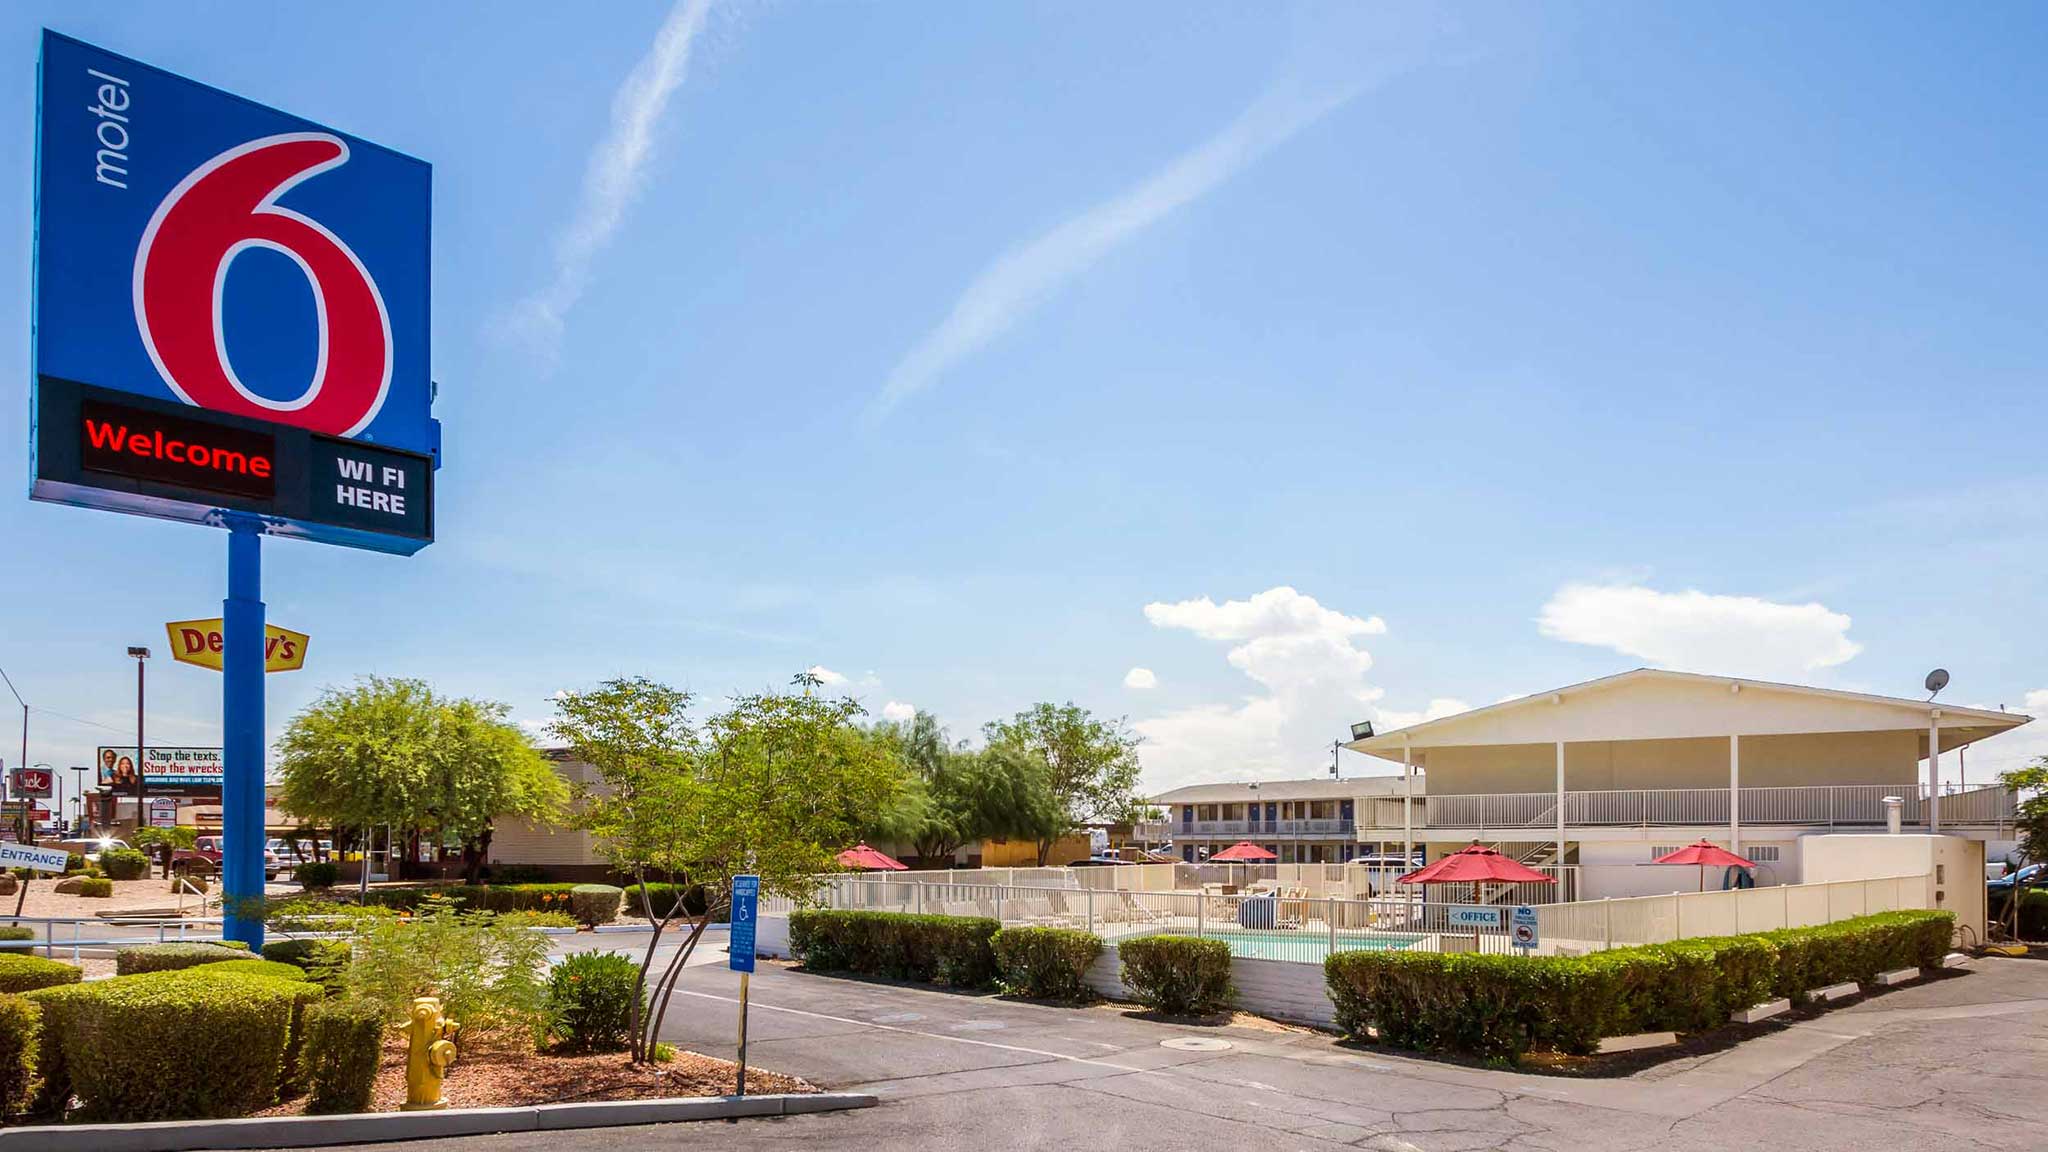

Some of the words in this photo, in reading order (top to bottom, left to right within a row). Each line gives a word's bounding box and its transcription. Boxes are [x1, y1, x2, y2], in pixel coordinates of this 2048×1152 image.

[87, 68, 130, 189] motel
[132, 131, 394, 438] 6
[85, 419, 271, 478] Welcome
[337, 457, 373, 483] WI
[382, 466, 405, 489] FI
[336, 484, 406, 515] HERE
[180, 628, 296, 661] Dey's
[144, 761, 167, 775] Stop
[169, 762, 185, 774] the
[149, 749, 172, 763] Stop
[175, 750, 191, 761] the
[193, 751, 221, 761] texts.
[1, 848, 65, 866] ENTRANCE
[1460, 911, 1497, 923] OFFICE
[1517, 907, 1532, 916] NO
